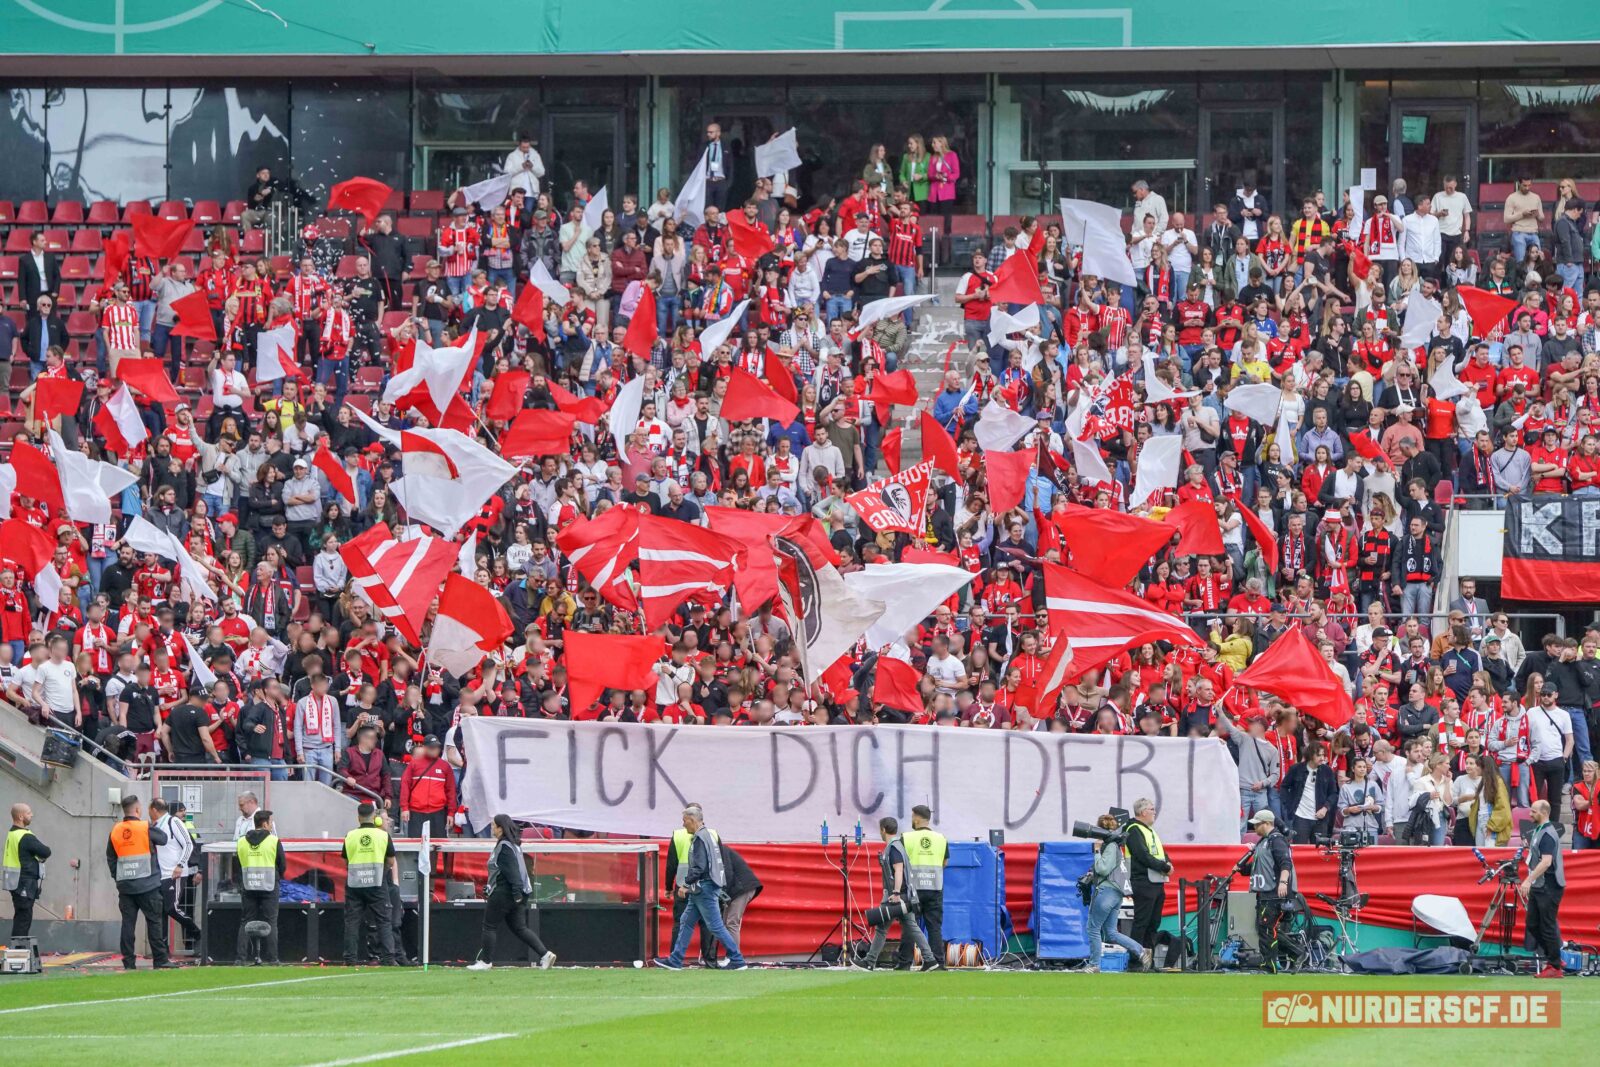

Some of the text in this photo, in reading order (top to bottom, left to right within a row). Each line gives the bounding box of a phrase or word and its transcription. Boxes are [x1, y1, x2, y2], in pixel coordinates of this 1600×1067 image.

[496, 724, 1196, 841] FICK DICH DFB!
